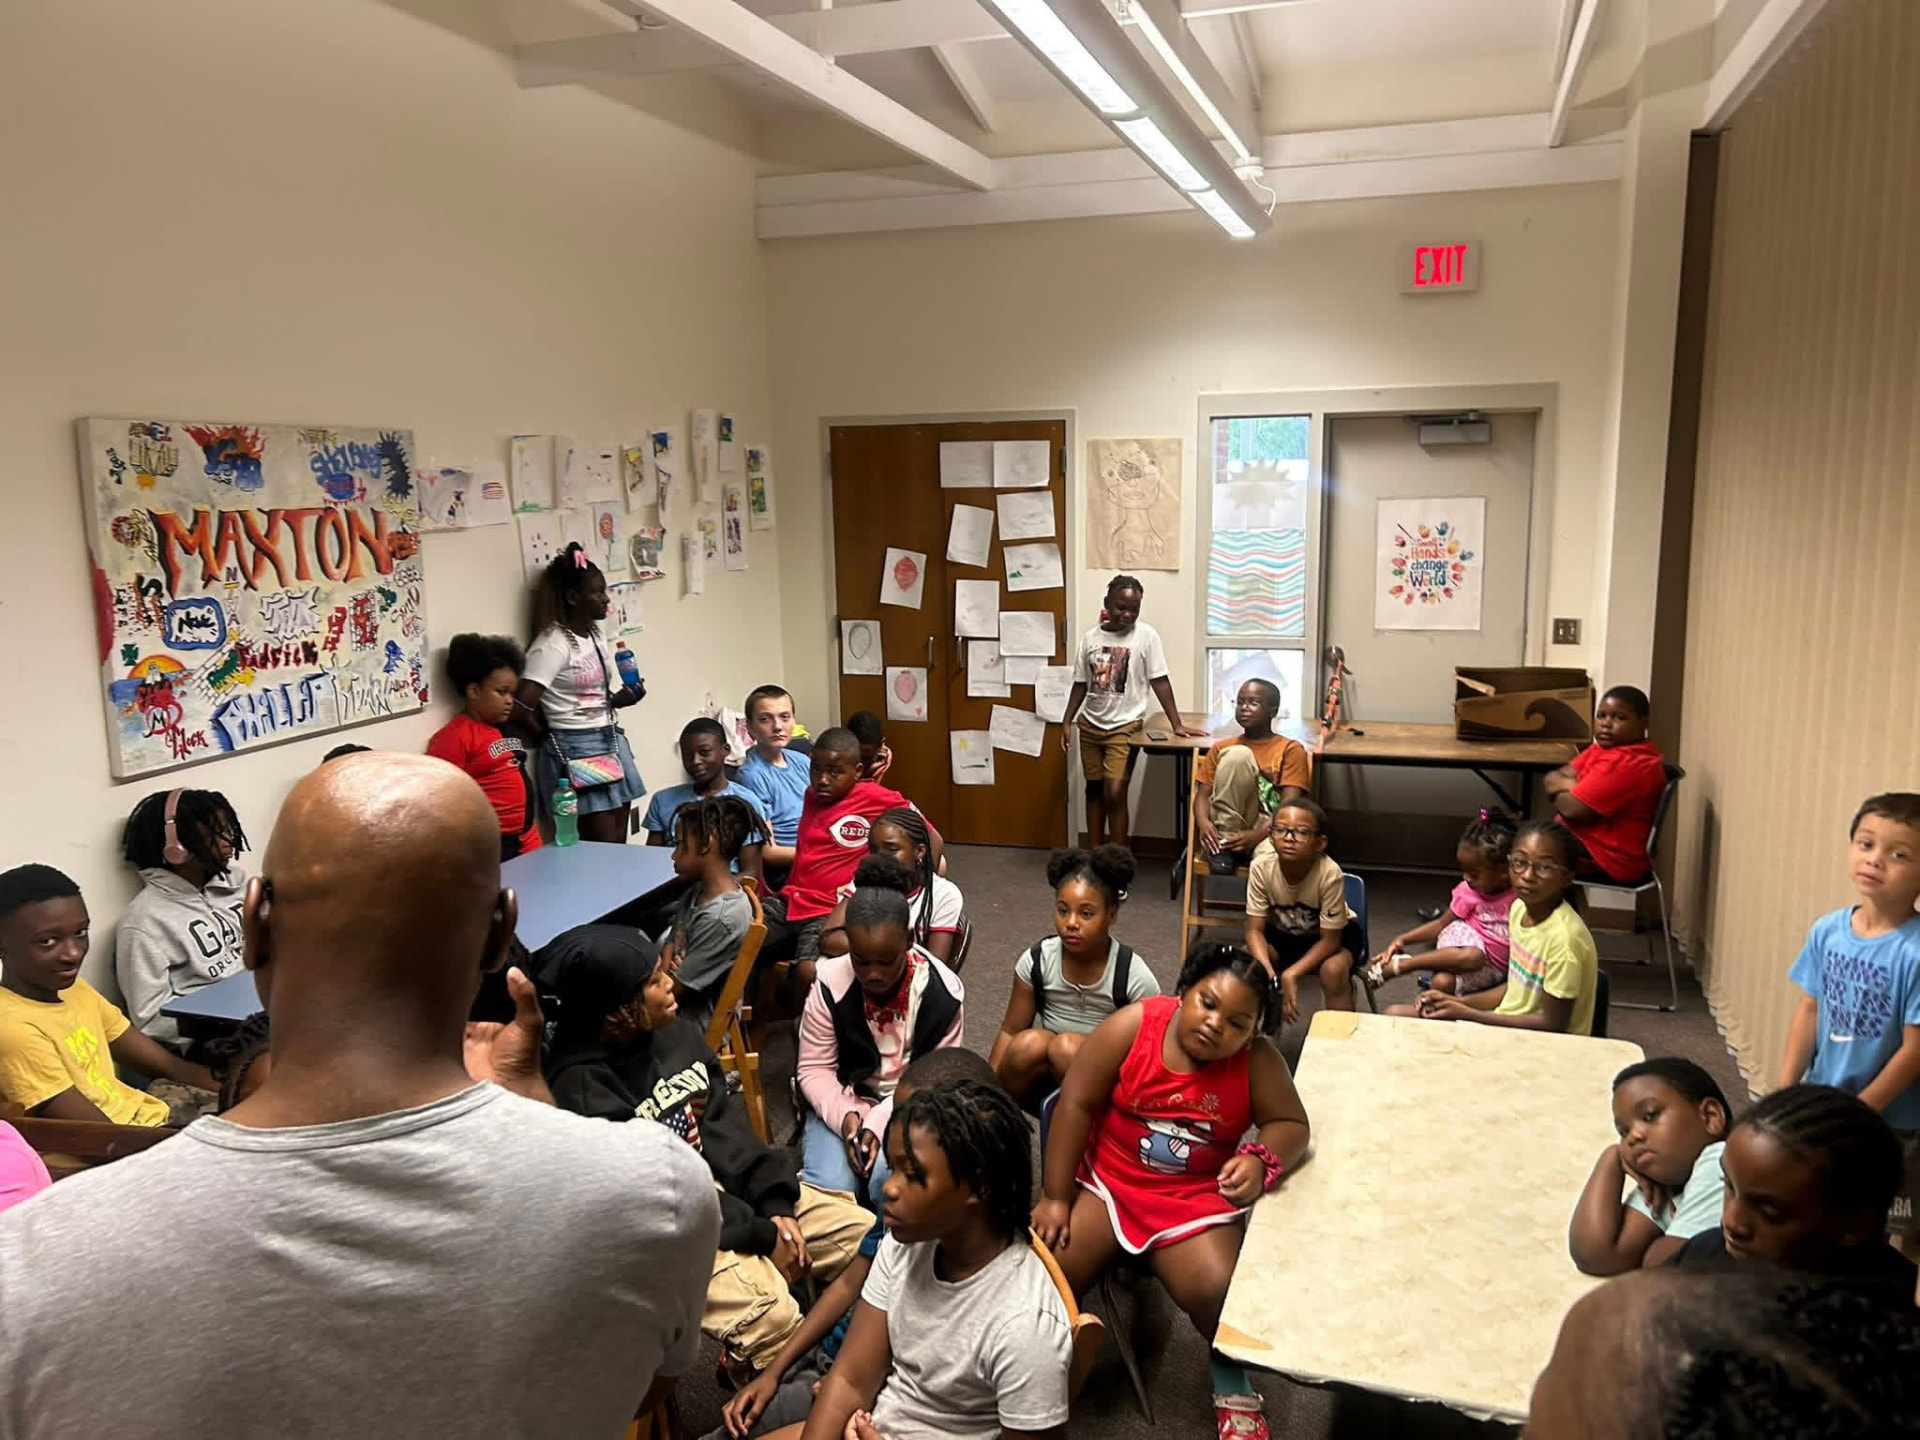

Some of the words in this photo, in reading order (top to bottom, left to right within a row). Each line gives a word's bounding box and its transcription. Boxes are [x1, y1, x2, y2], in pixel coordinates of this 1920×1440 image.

[1414, 244, 1468, 286] EXIT
[146, 504, 396, 600] MAXTON
[1411, 547, 1446, 559] Hands
[1411, 559, 1449, 574] change
[1410, 570, 1446, 587] World
[841, 826, 870, 837] REDS
[1888, 1197, 1912, 1217] BA
